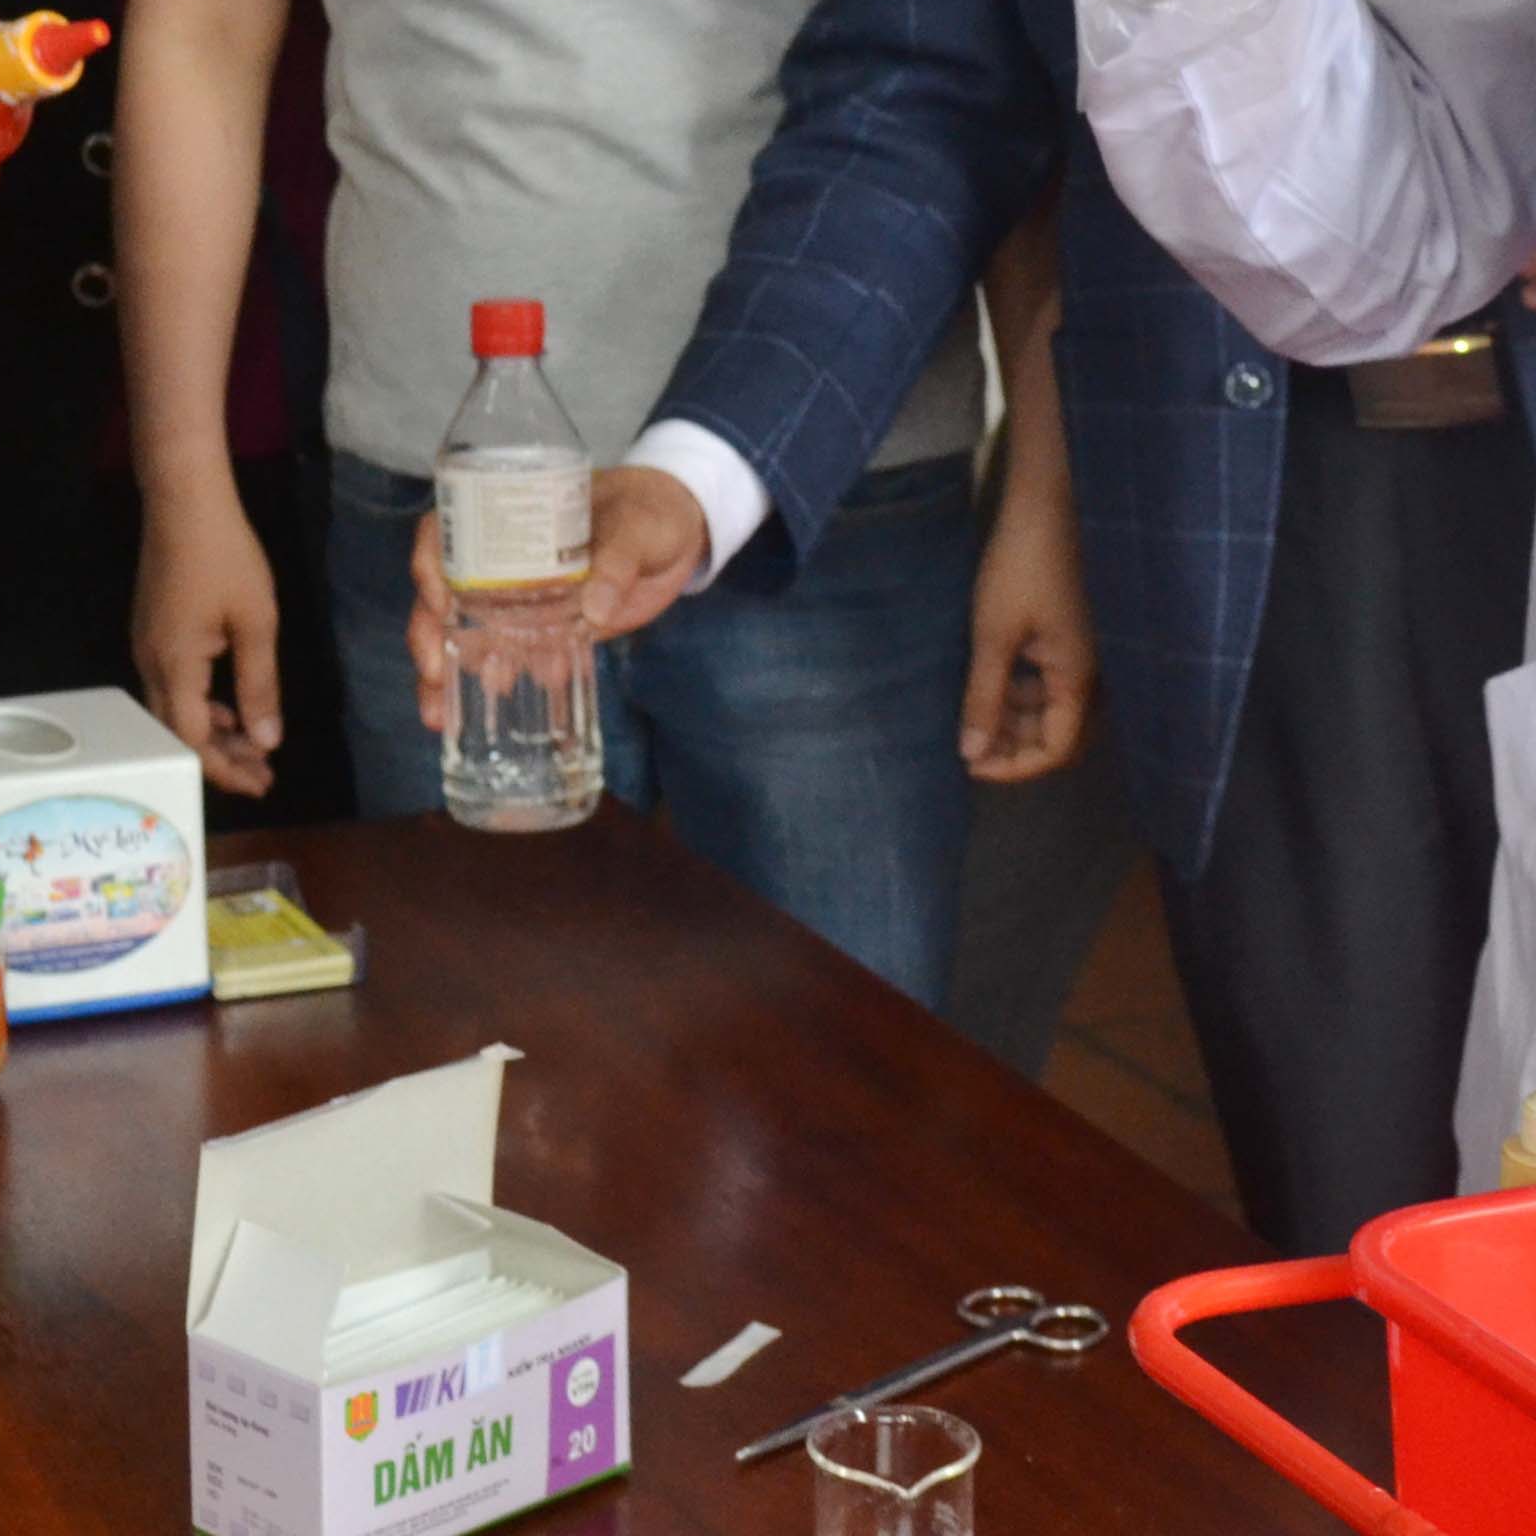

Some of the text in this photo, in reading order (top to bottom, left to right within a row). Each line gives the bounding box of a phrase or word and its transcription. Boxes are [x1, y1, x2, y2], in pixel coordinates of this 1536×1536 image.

[374, 1413, 513, 1507] DẤM ĂN
[568, 1424, 596, 1462] 20
